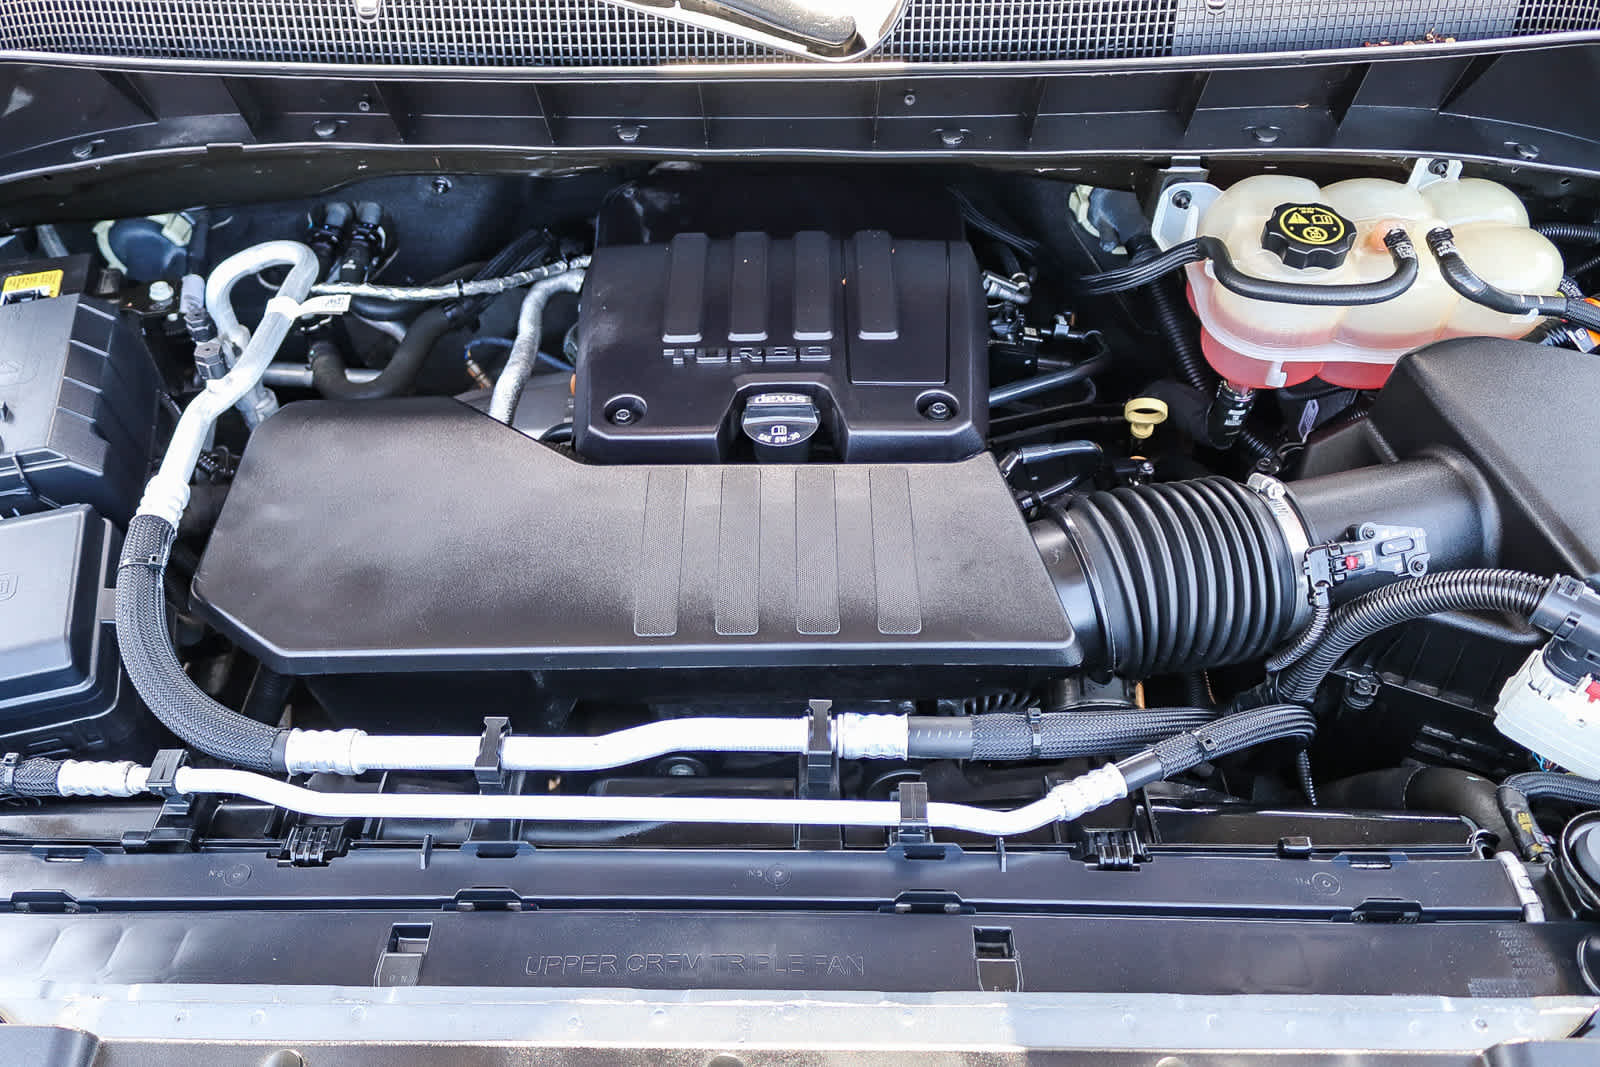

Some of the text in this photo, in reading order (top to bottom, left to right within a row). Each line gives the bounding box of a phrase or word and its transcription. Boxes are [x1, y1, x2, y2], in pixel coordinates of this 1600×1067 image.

[662, 346, 832, 365] TURBO
[754, 393, 809, 404] dexos
[525, 952, 865, 976] UPPER CRFM TRIPLE FAN
